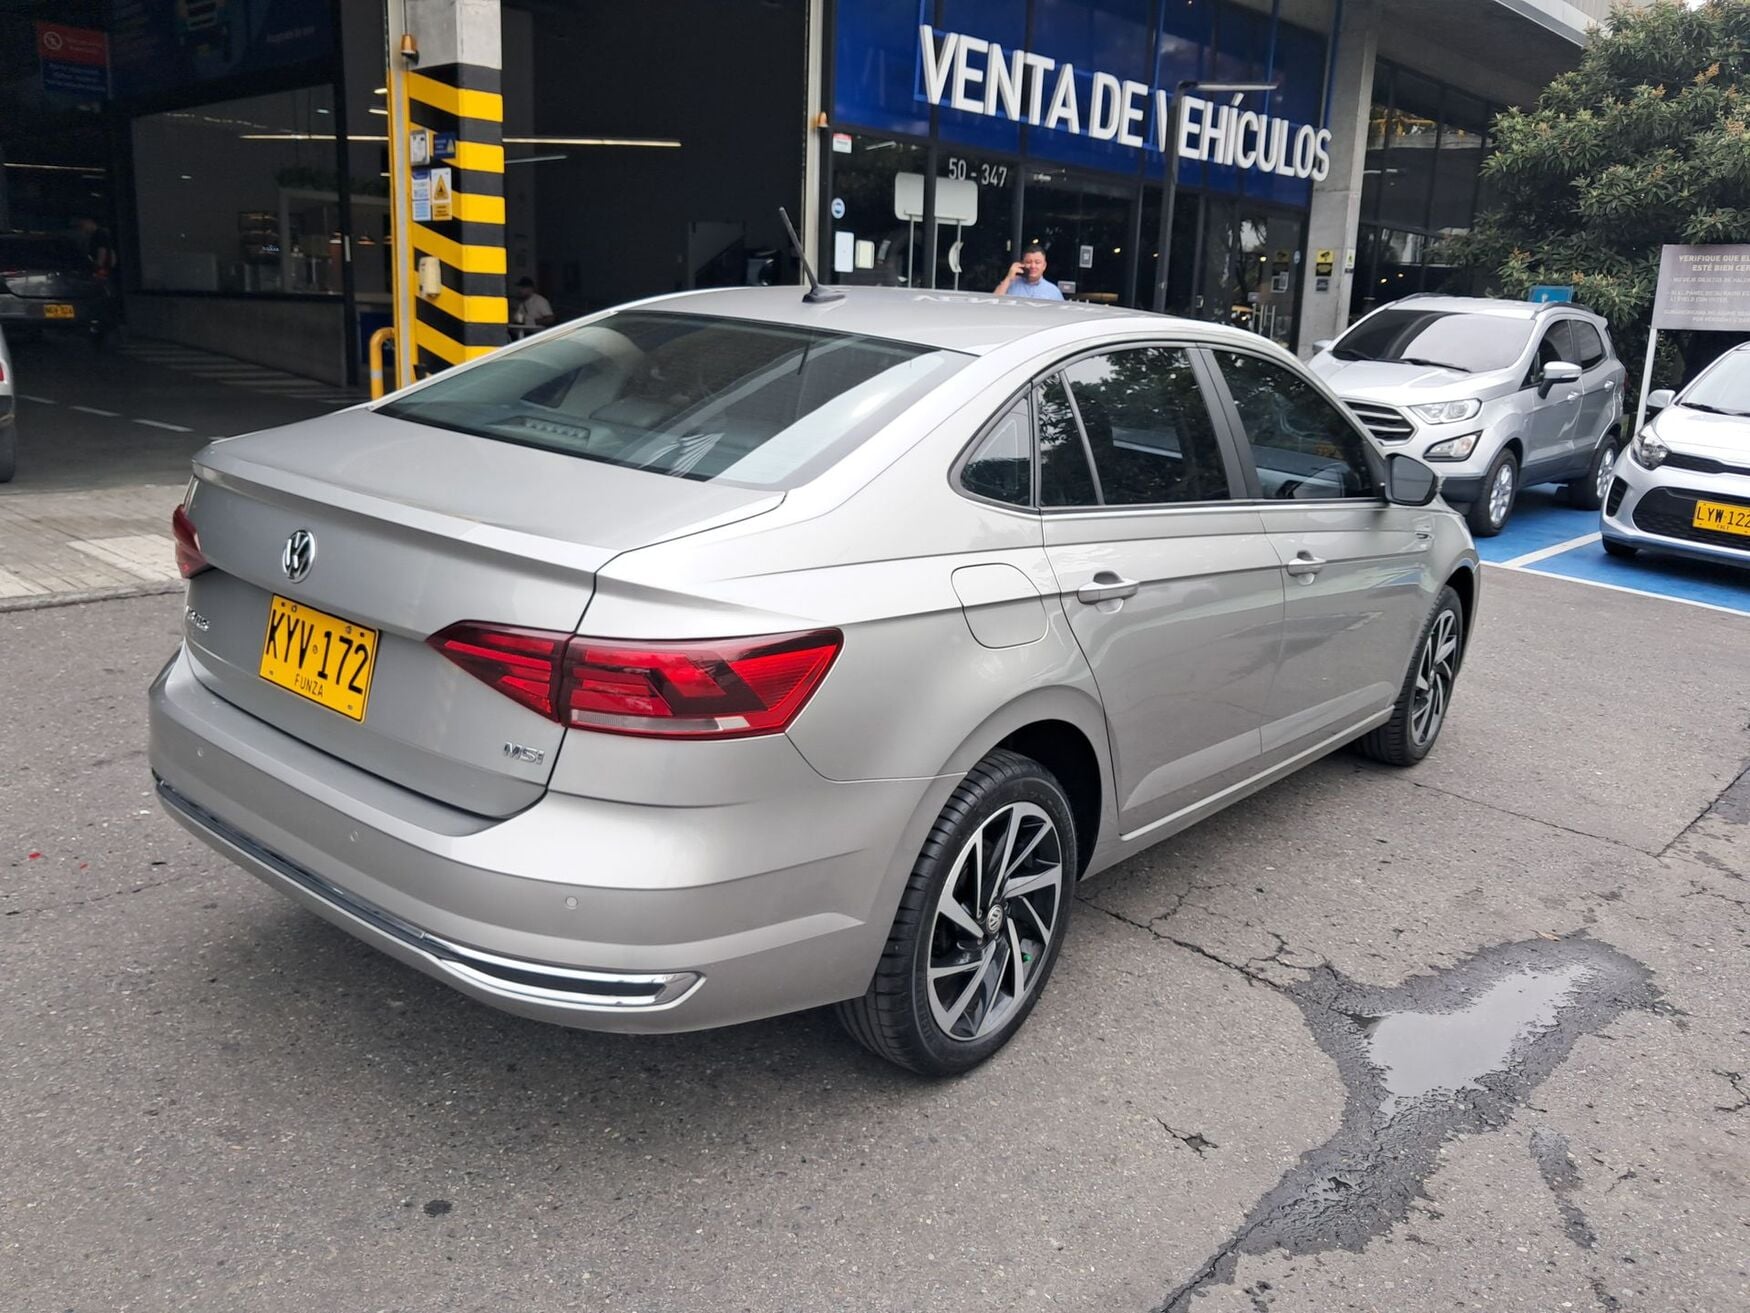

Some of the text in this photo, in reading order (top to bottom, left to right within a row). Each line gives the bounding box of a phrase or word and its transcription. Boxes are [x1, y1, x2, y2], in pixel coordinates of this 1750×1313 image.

[919, 24, 1080, 134] VENTA
[1088, 71, 1148, 147] DE
[948, 157, 967, 180] 50
[981, 163, 1007, 187] 347
[1679, 254, 1721, 262] VERIFIQUE
[1722, 254, 1739, 262] QUE
[1714, 264, 1734, 272] BIEN
[1696, 506, 1724, 523] LYW
[266, 609, 314, 669] KYV
[317, 630, 369, 695] 172
[294, 673, 325, 698] FUNZA
